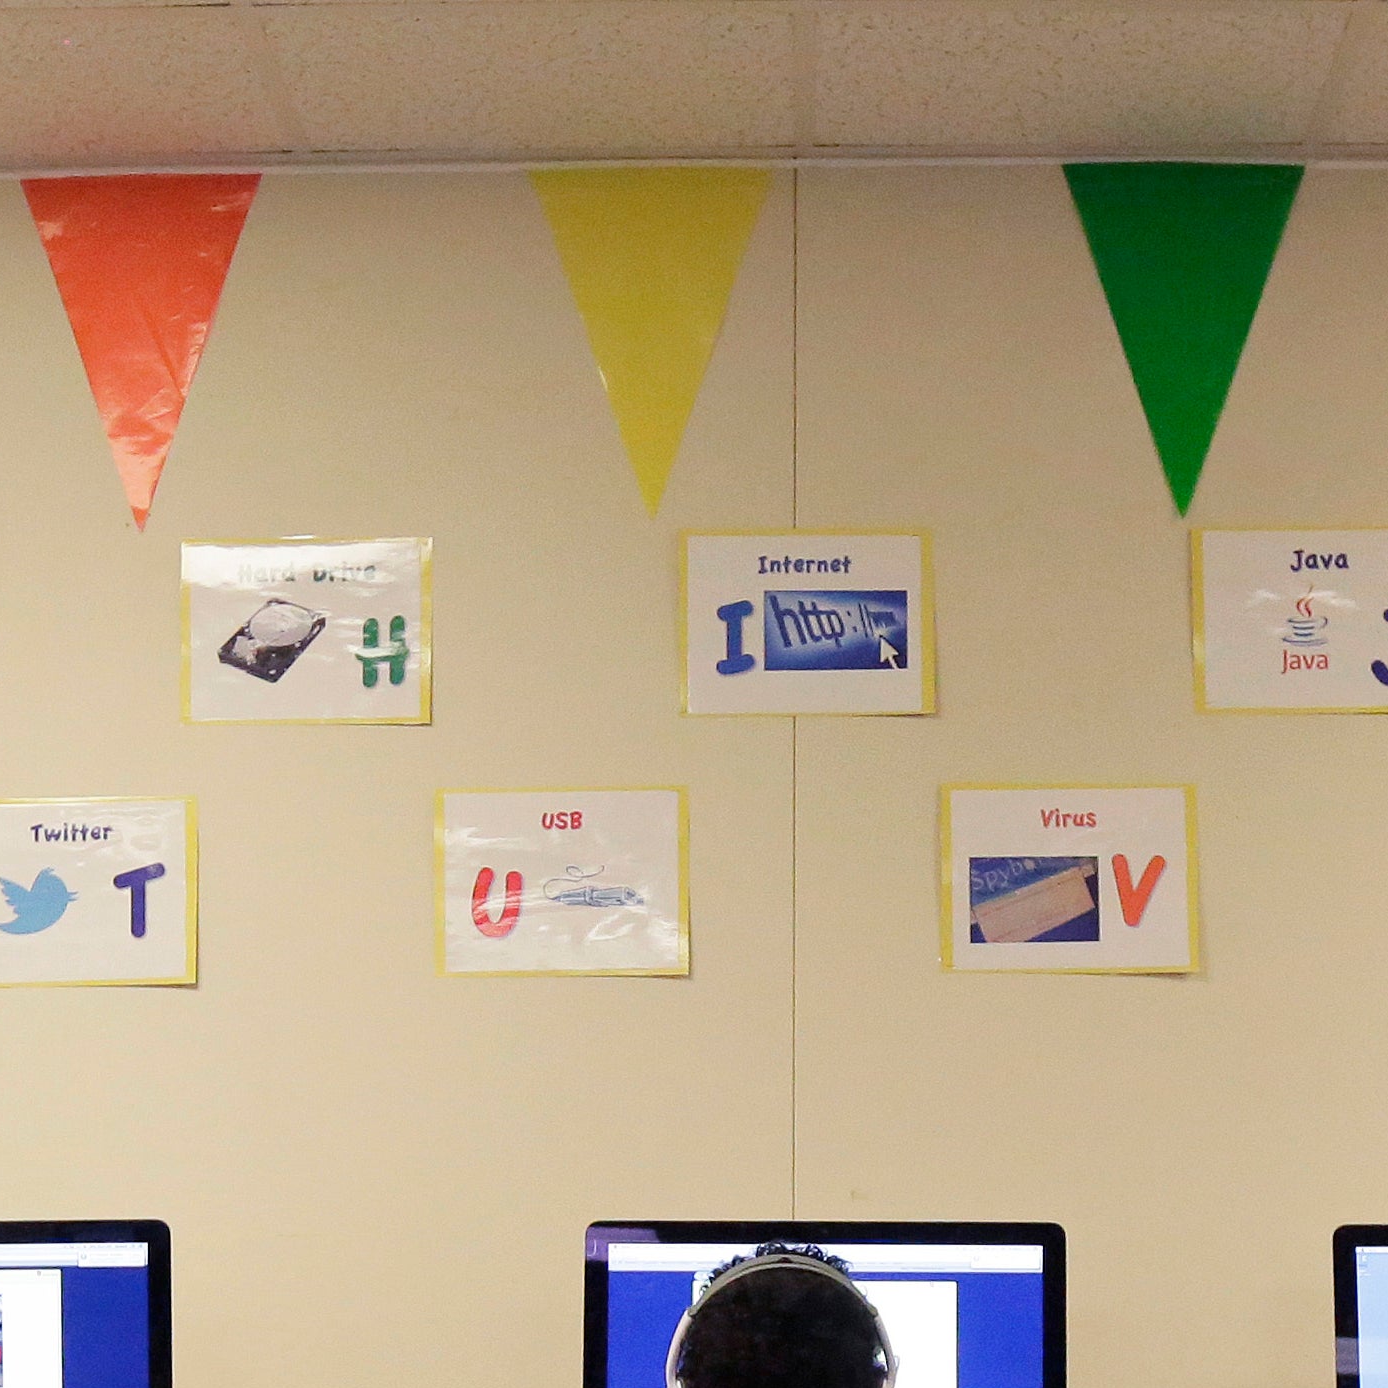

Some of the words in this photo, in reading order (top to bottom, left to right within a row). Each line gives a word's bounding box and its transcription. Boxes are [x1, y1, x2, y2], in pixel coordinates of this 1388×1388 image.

[757, 555, 853, 575] Internet
[1290, 548, 1350, 573] Java
[716, 600, 756, 676] I
[355, 615, 409, 688] H
[1281, 650, 1329, 675] Java
[541, 811, 583, 830] USB
[1040, 808, 1097, 829] Virus
[30, 822, 114, 842] Twitter
[113, 862, 166, 939] T
[471, 866, 523, 938] U
[1111, 853, 1167, 927] V
